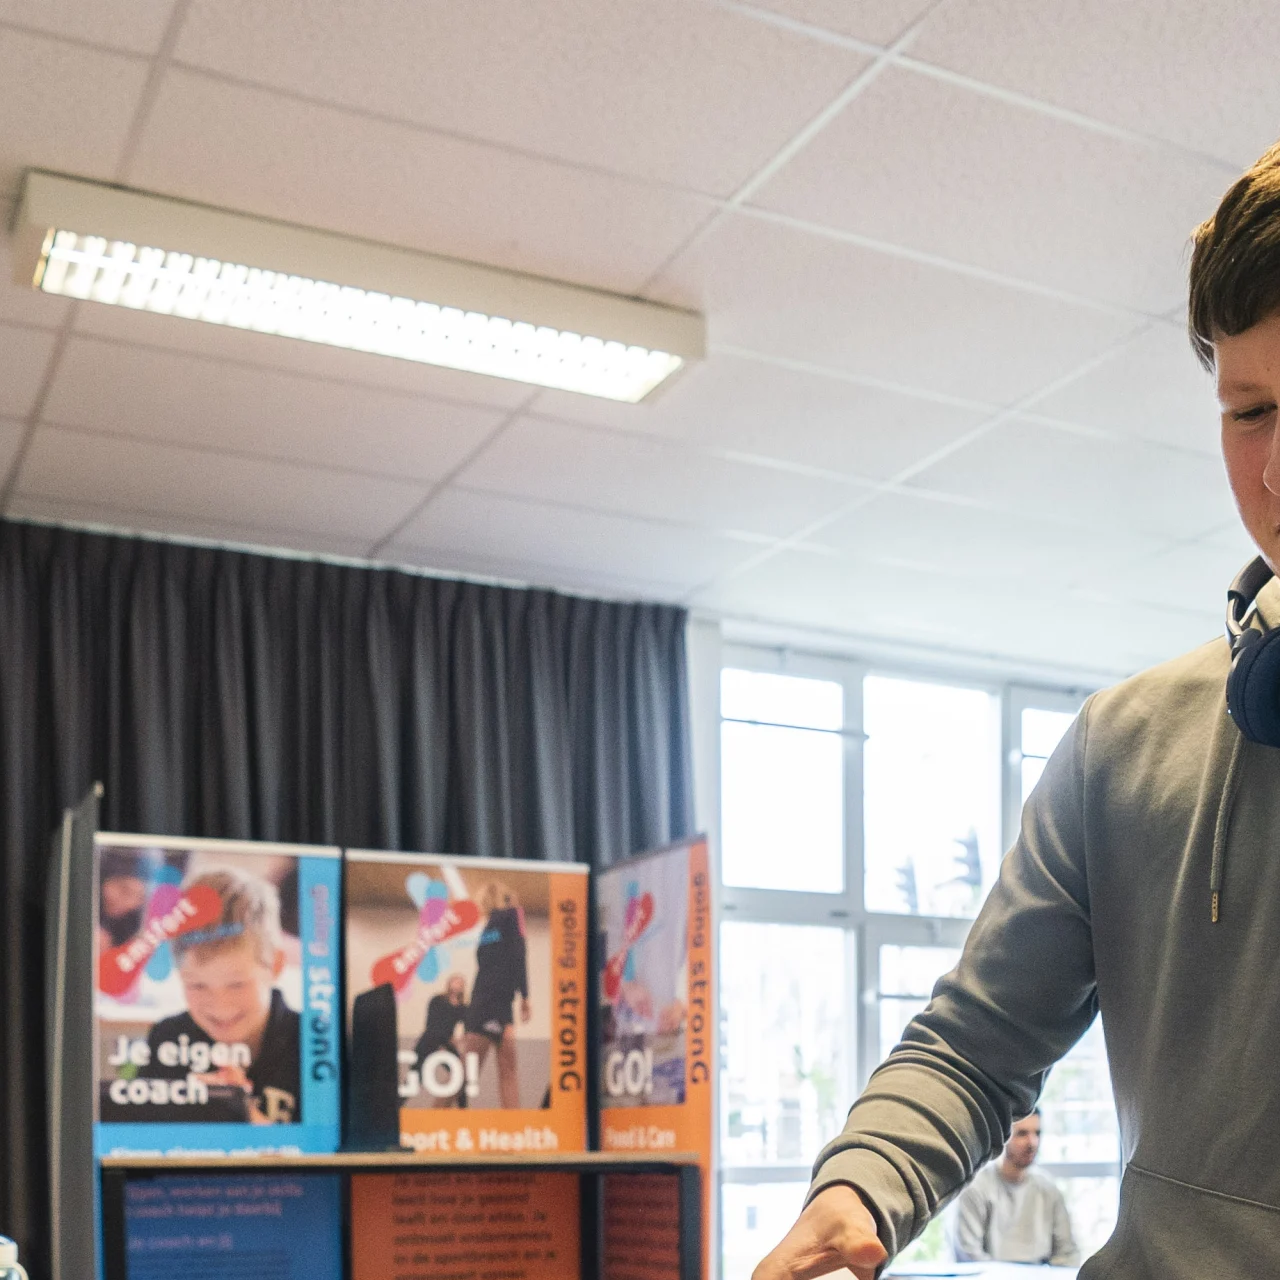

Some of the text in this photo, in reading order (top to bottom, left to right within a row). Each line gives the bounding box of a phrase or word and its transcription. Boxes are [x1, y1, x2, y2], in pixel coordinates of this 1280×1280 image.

[558, 899, 582, 1093] going stronG
[108, 1035, 251, 1072] Je eigen
[398, 1050, 480, 1098] GO!
[605, 1051, 654, 1097] GO!
[109, 1072, 209, 1105] coach
[456, 1128, 473, 1150] &
[479, 1126, 558, 1151] Health
